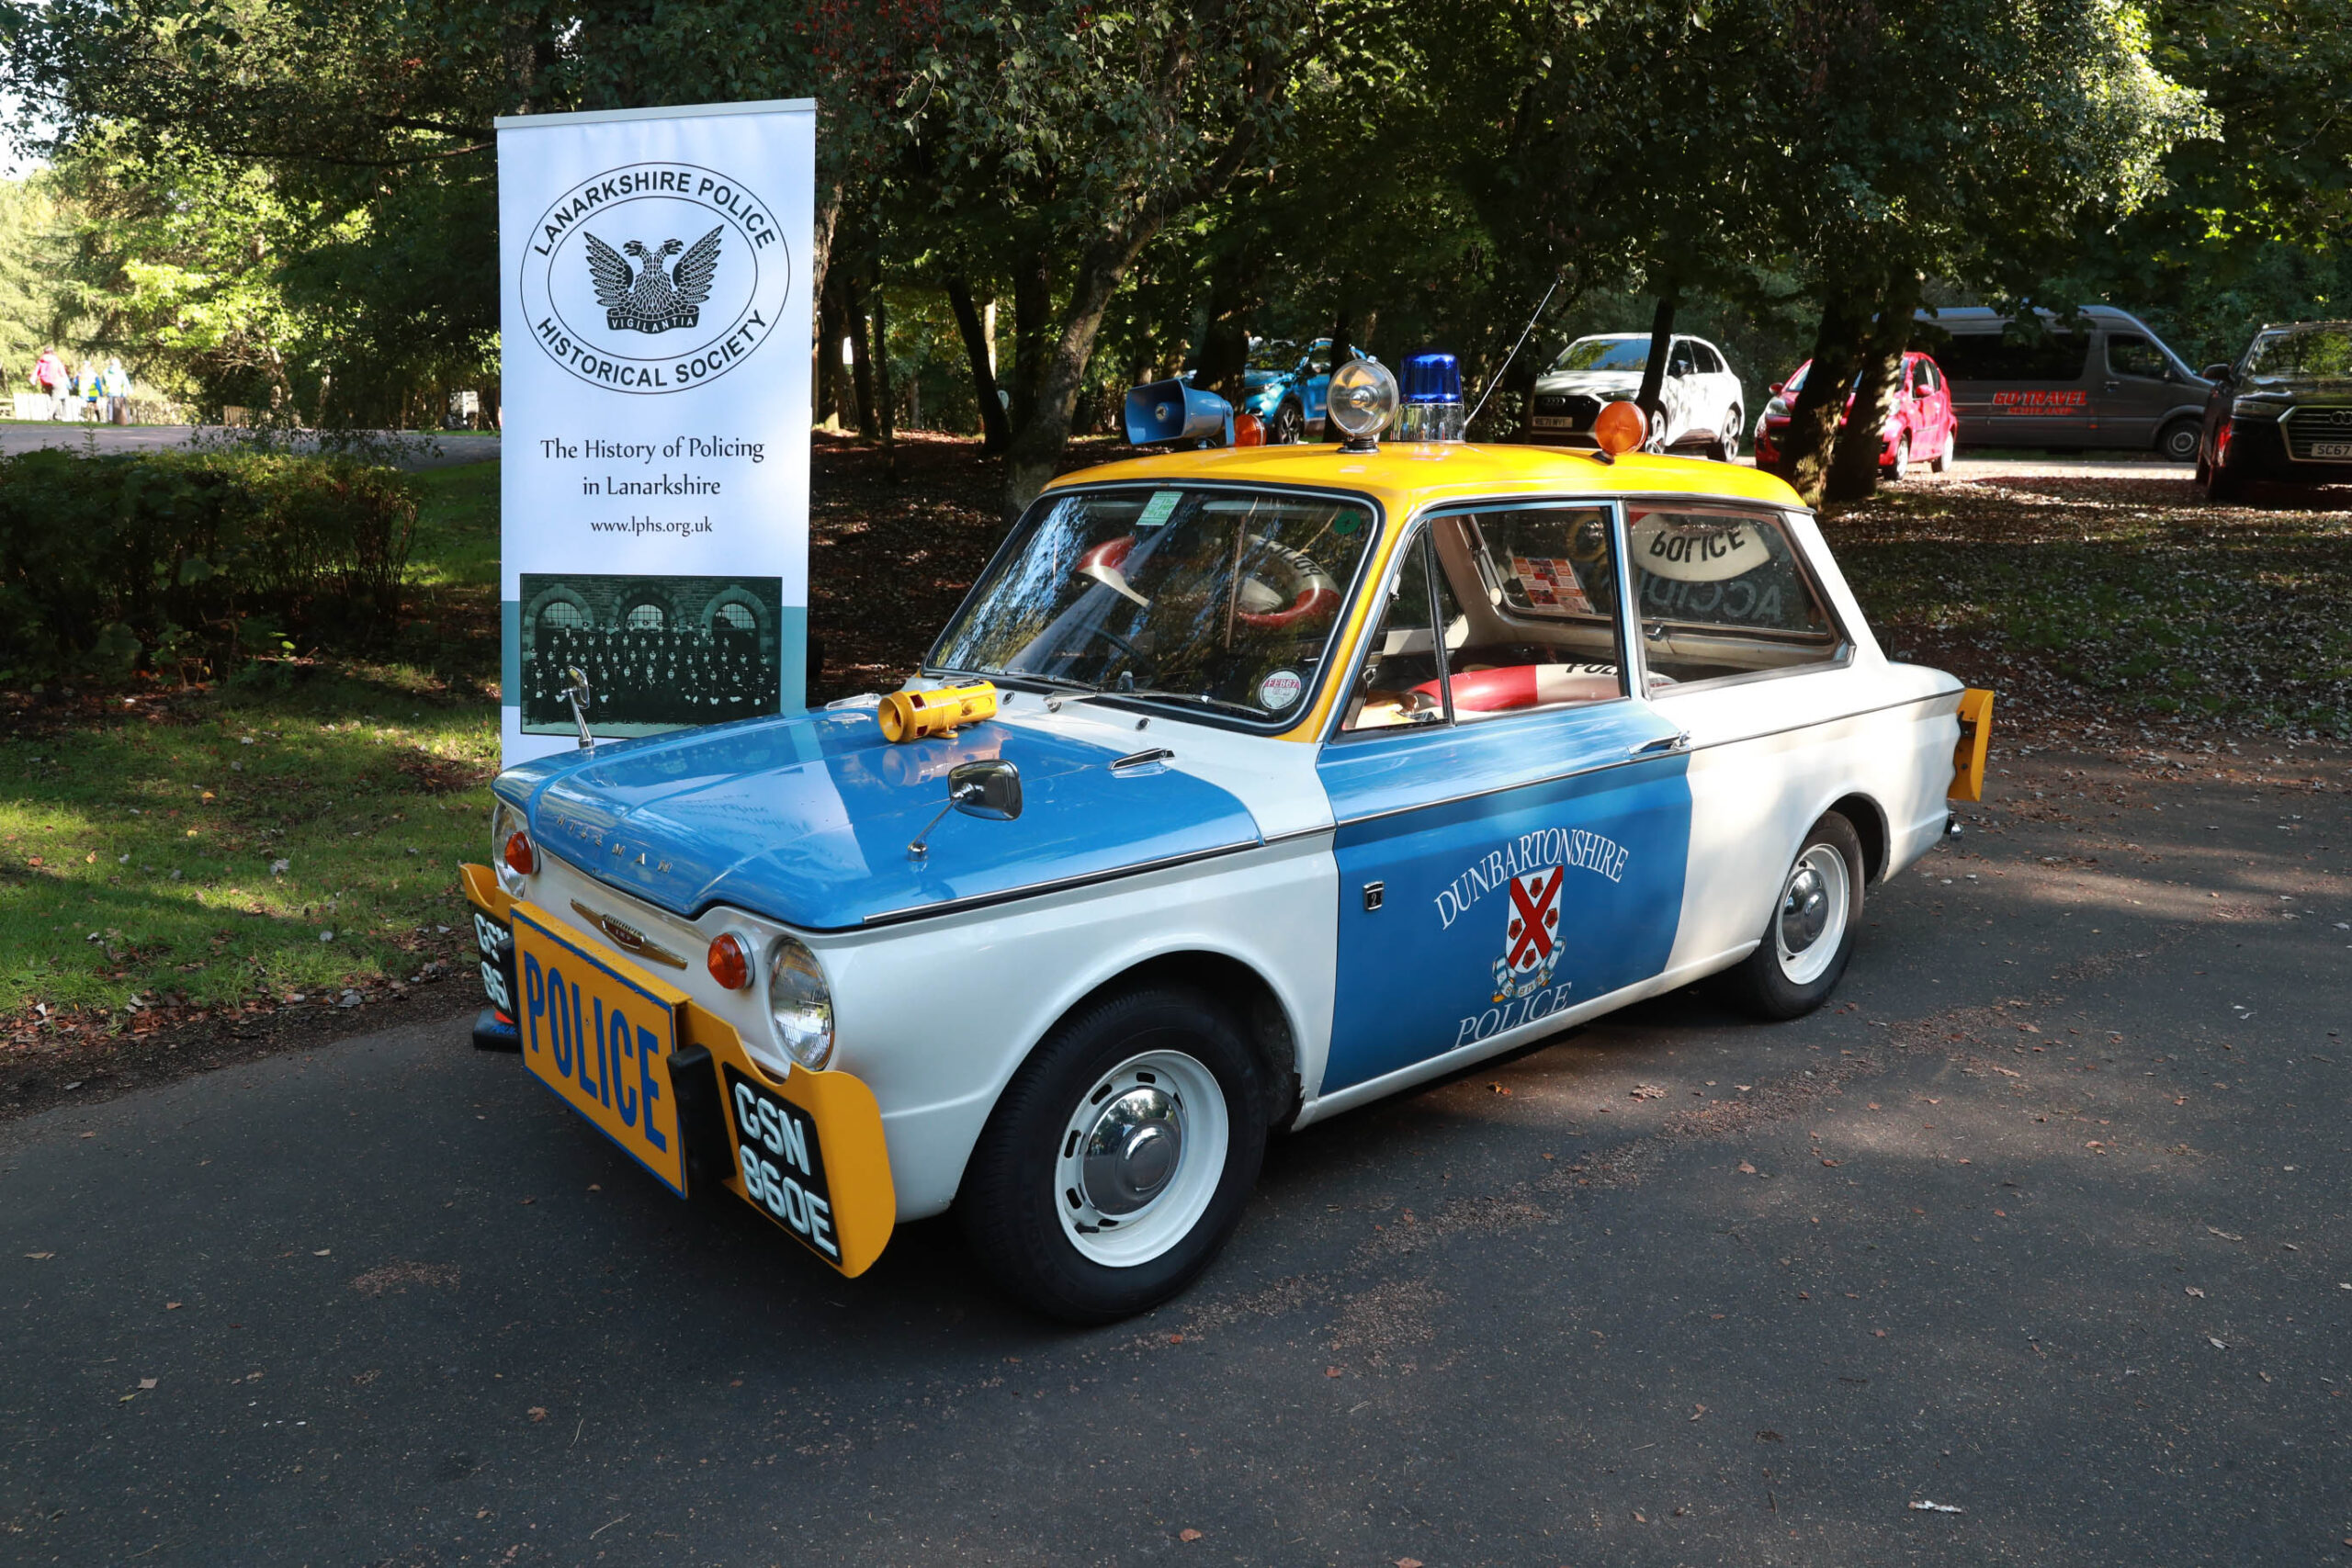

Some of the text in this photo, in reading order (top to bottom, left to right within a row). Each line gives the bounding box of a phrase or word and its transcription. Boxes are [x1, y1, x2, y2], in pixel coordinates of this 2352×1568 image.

[534, 171, 775, 256] LANARKSHIRE POLICE
[537, 309, 767, 388] HISTORICAL SOCIETY
[611, 317, 695, 333] VIGILANTIA
[540, 434, 764, 465] The History of Policing
[582, 473, 721, 496] in Lanarkshire
[590, 515, 713, 537] www.lphs.org.uk
[1433, 828, 1630, 931] DUNBARTONSHIRE
[524, 950, 667, 1154] POLICE
[1451, 981, 1573, 1050] POLICE
[735, 1081, 811, 1177] GSN
[739, 1144, 839, 1258] 860E
